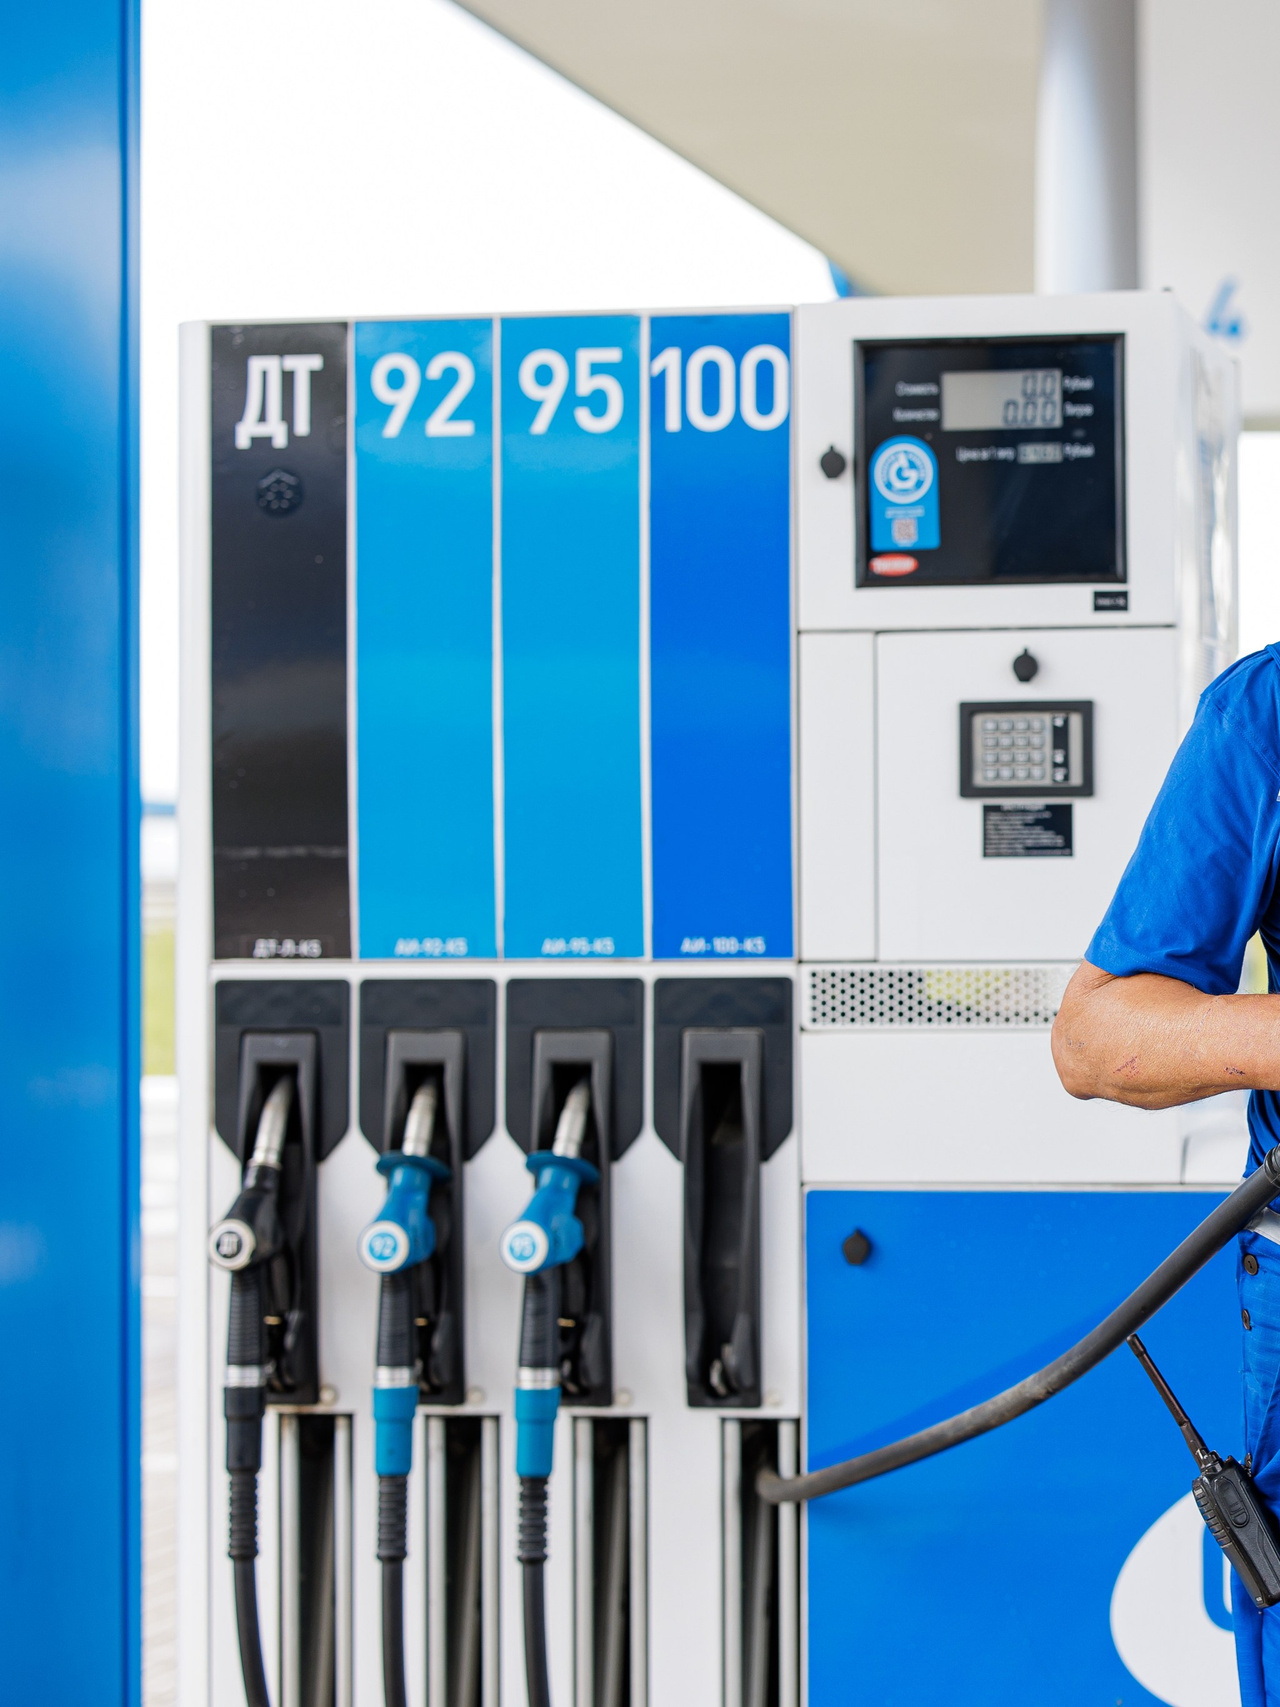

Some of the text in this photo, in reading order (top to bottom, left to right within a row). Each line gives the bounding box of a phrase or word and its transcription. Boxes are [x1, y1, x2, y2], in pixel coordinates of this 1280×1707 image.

[235, 354, 323, 449] ДТ
[370, 351, 475, 439] 92
[517, 346, 624, 436] 95
[649, 344, 790, 433] 100
[372, 1236, 394, 1257] 92
